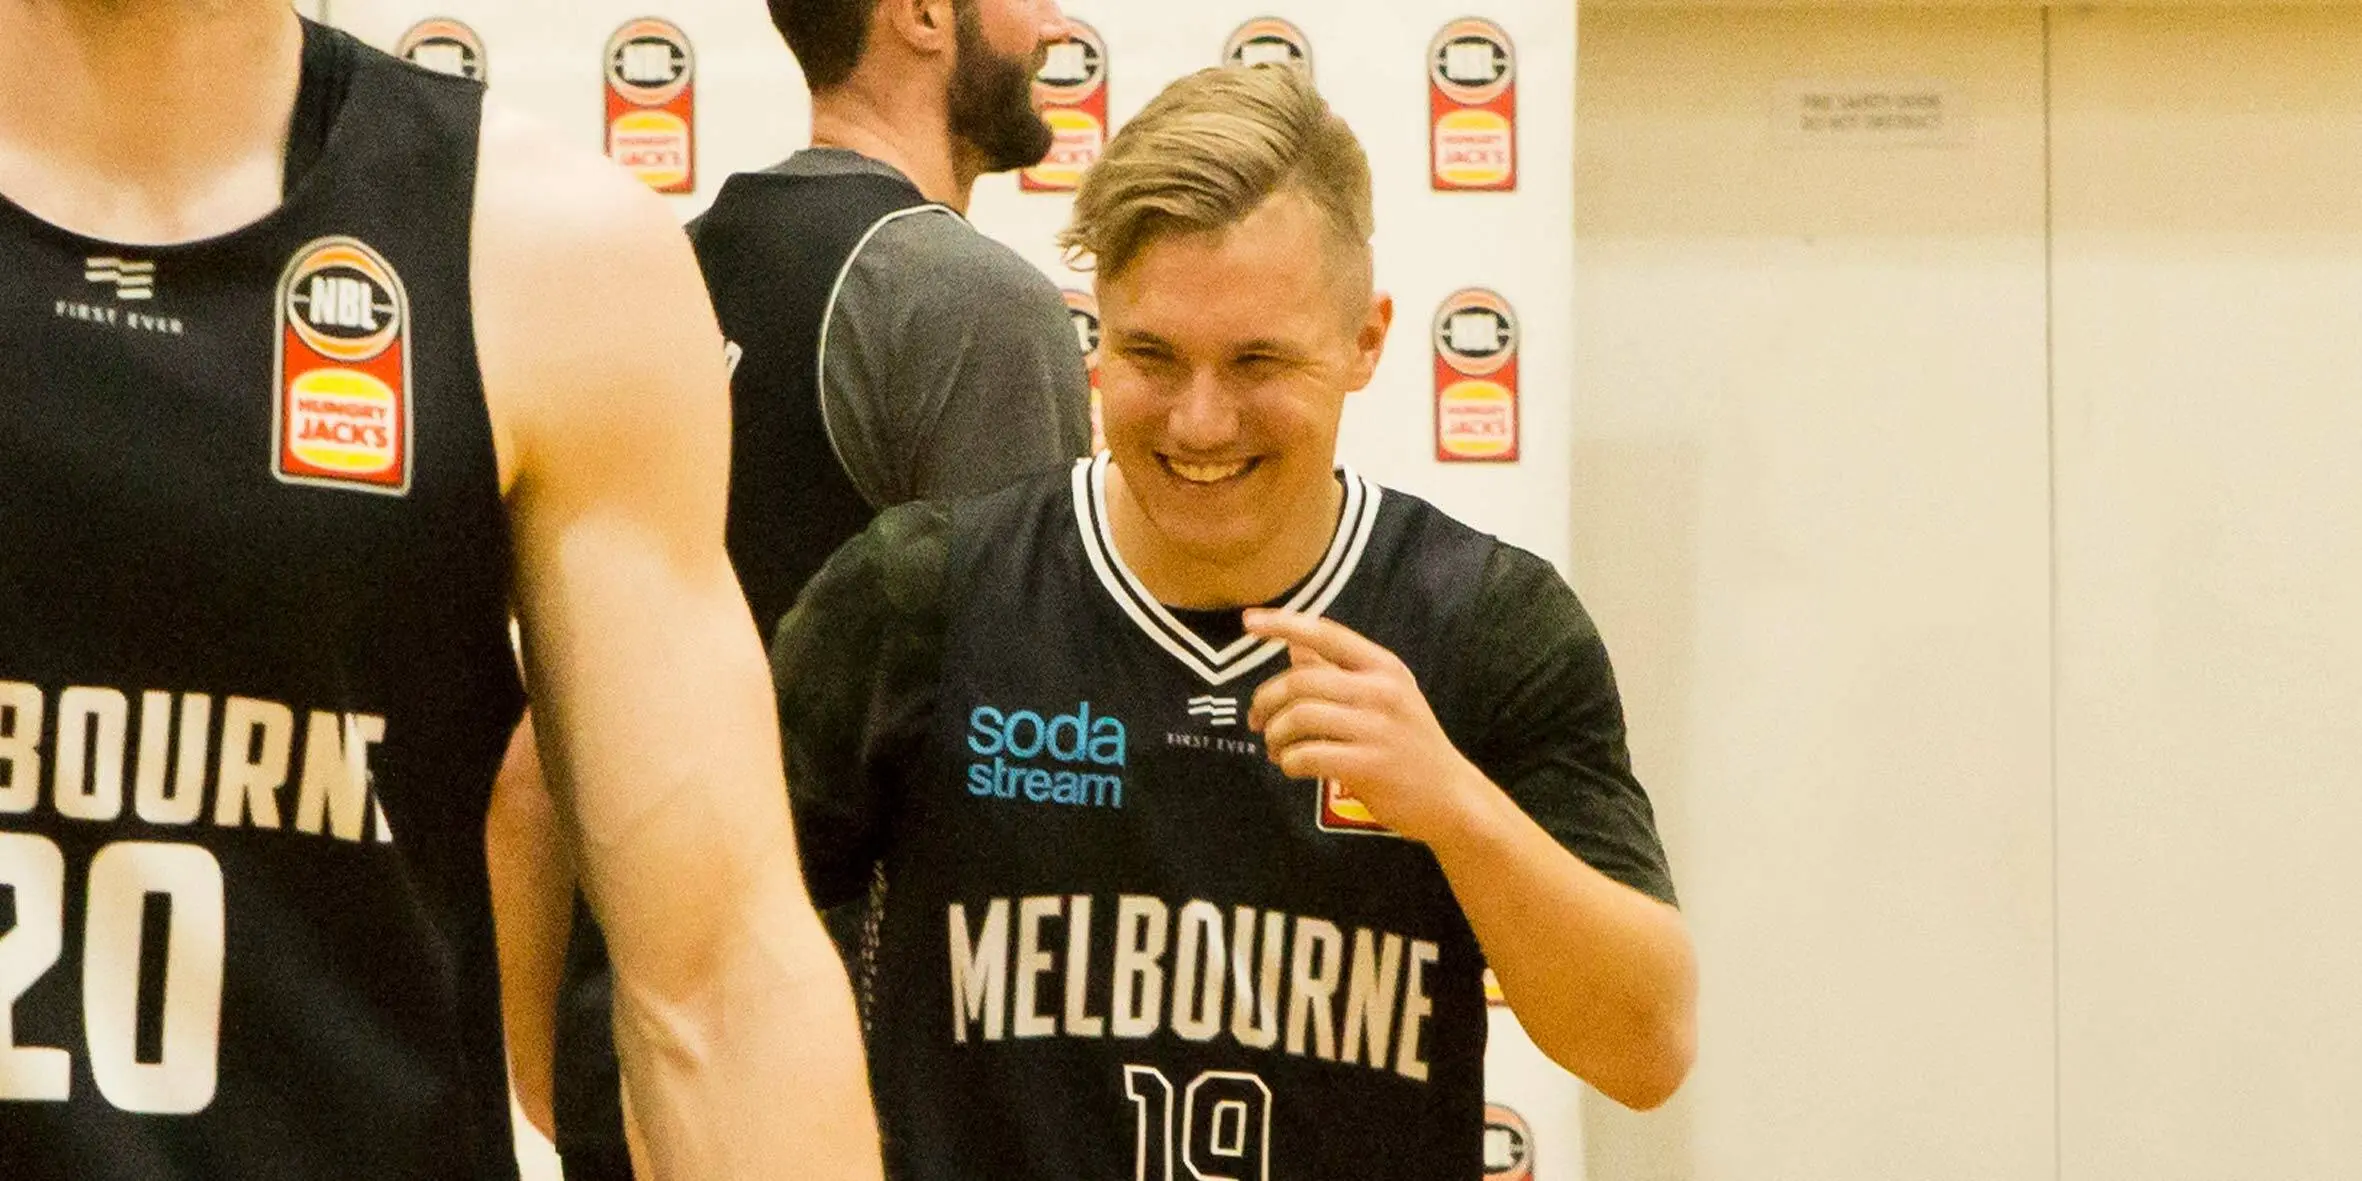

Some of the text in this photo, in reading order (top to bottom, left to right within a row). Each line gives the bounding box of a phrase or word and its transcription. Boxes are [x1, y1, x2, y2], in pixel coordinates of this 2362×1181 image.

[55, 300, 183, 334] FIRST EVER
[309, 275, 379, 332] NBL
[297, 418, 389, 449] JACK'S
[967, 701, 1127, 767] soda
[1166, 732, 1257, 754] FIRST EVER
[966, 756, 1123, 809] stream
[948, 894, 1440, 1083] MELBOURNE
[1123, 1064, 1273, 1181] 19
